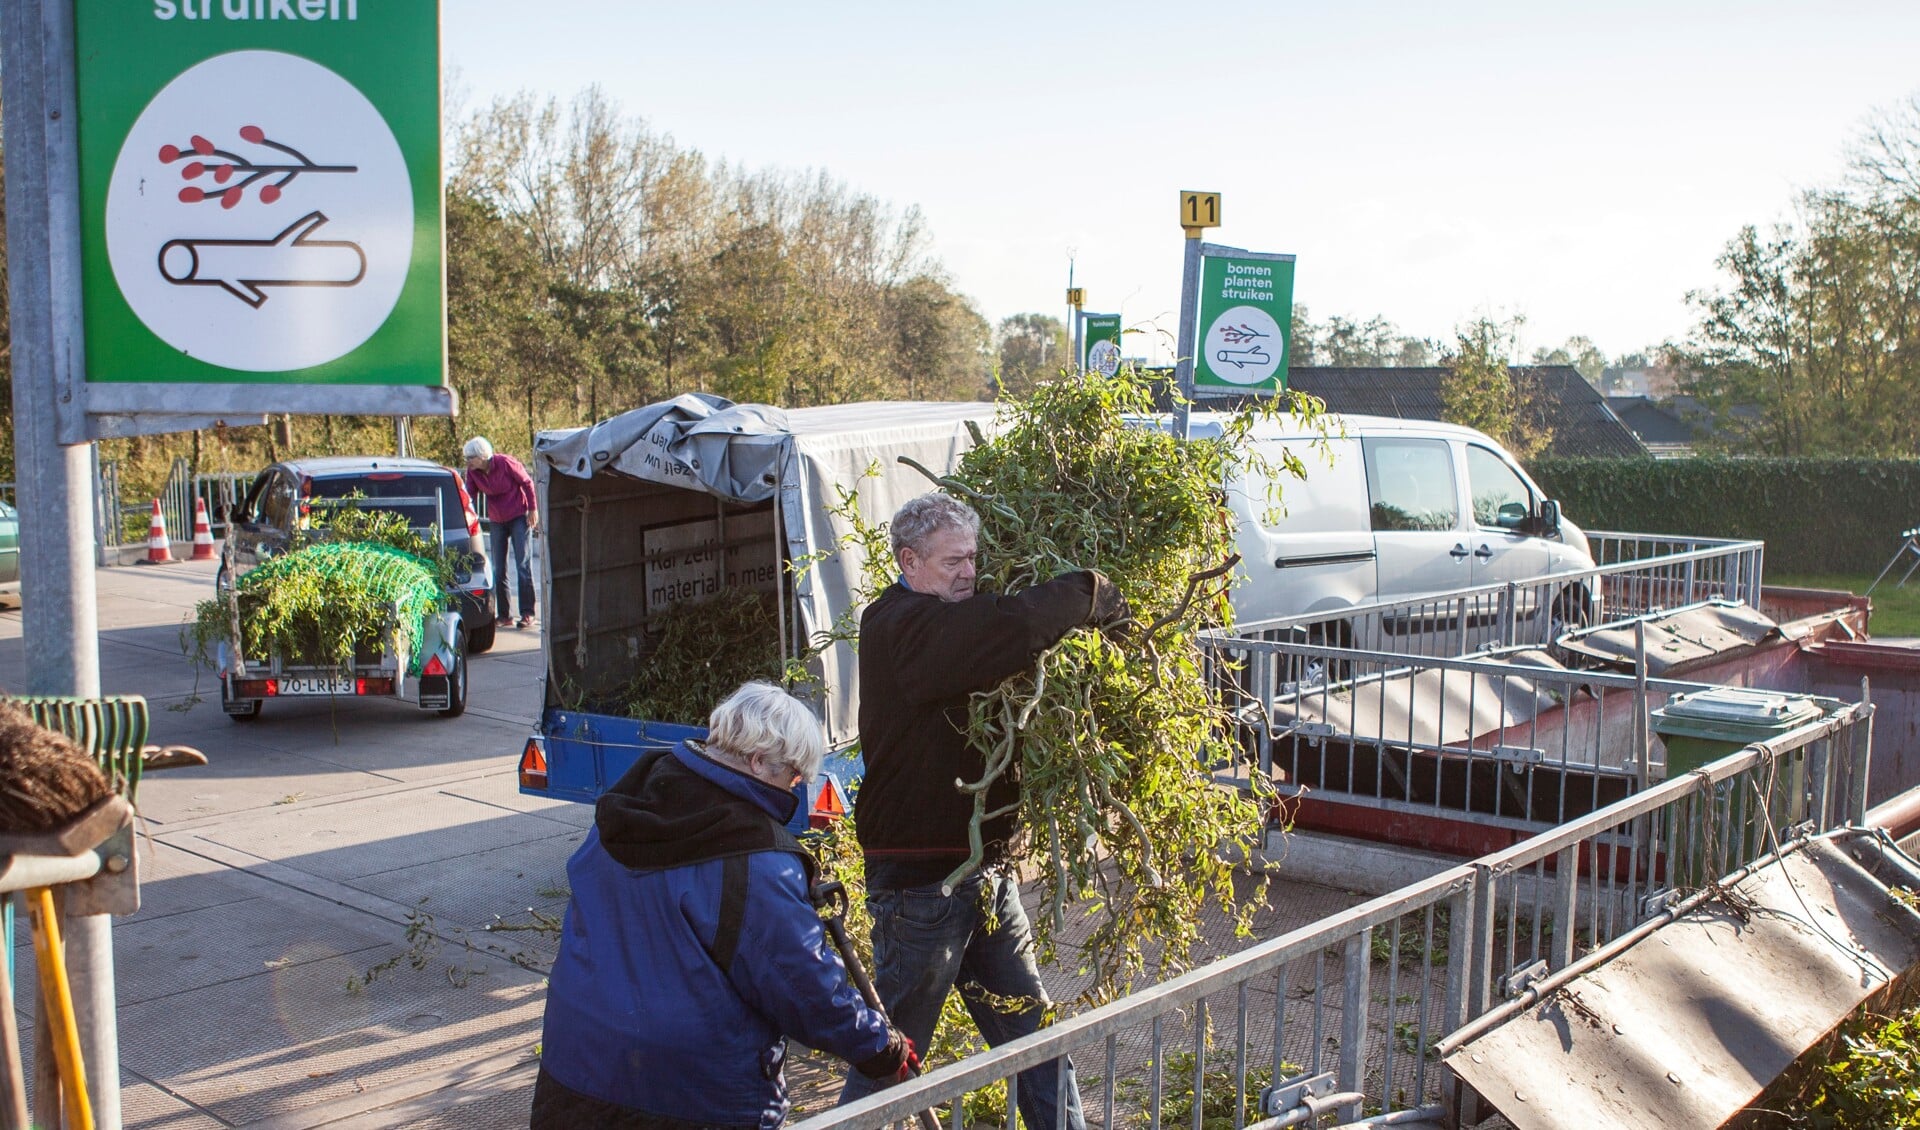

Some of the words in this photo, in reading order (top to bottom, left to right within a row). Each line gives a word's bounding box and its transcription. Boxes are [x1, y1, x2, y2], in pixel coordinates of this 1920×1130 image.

[153, 0, 358, 20] struiken
[1187, 195, 1215, 222] 11
[1227, 262, 1271, 276] bomen
[1224, 275, 1272, 289] planten
[1222, 288, 1274, 301] struiken
[644, 453, 660, 469] uw
[664, 461, 690, 476] zelf
[684, 539, 714, 565] zelf
[651, 569, 738, 605] materialn
[742, 564, 775, 585] mee
[282, 679, 352, 693] 70-LRH-3
